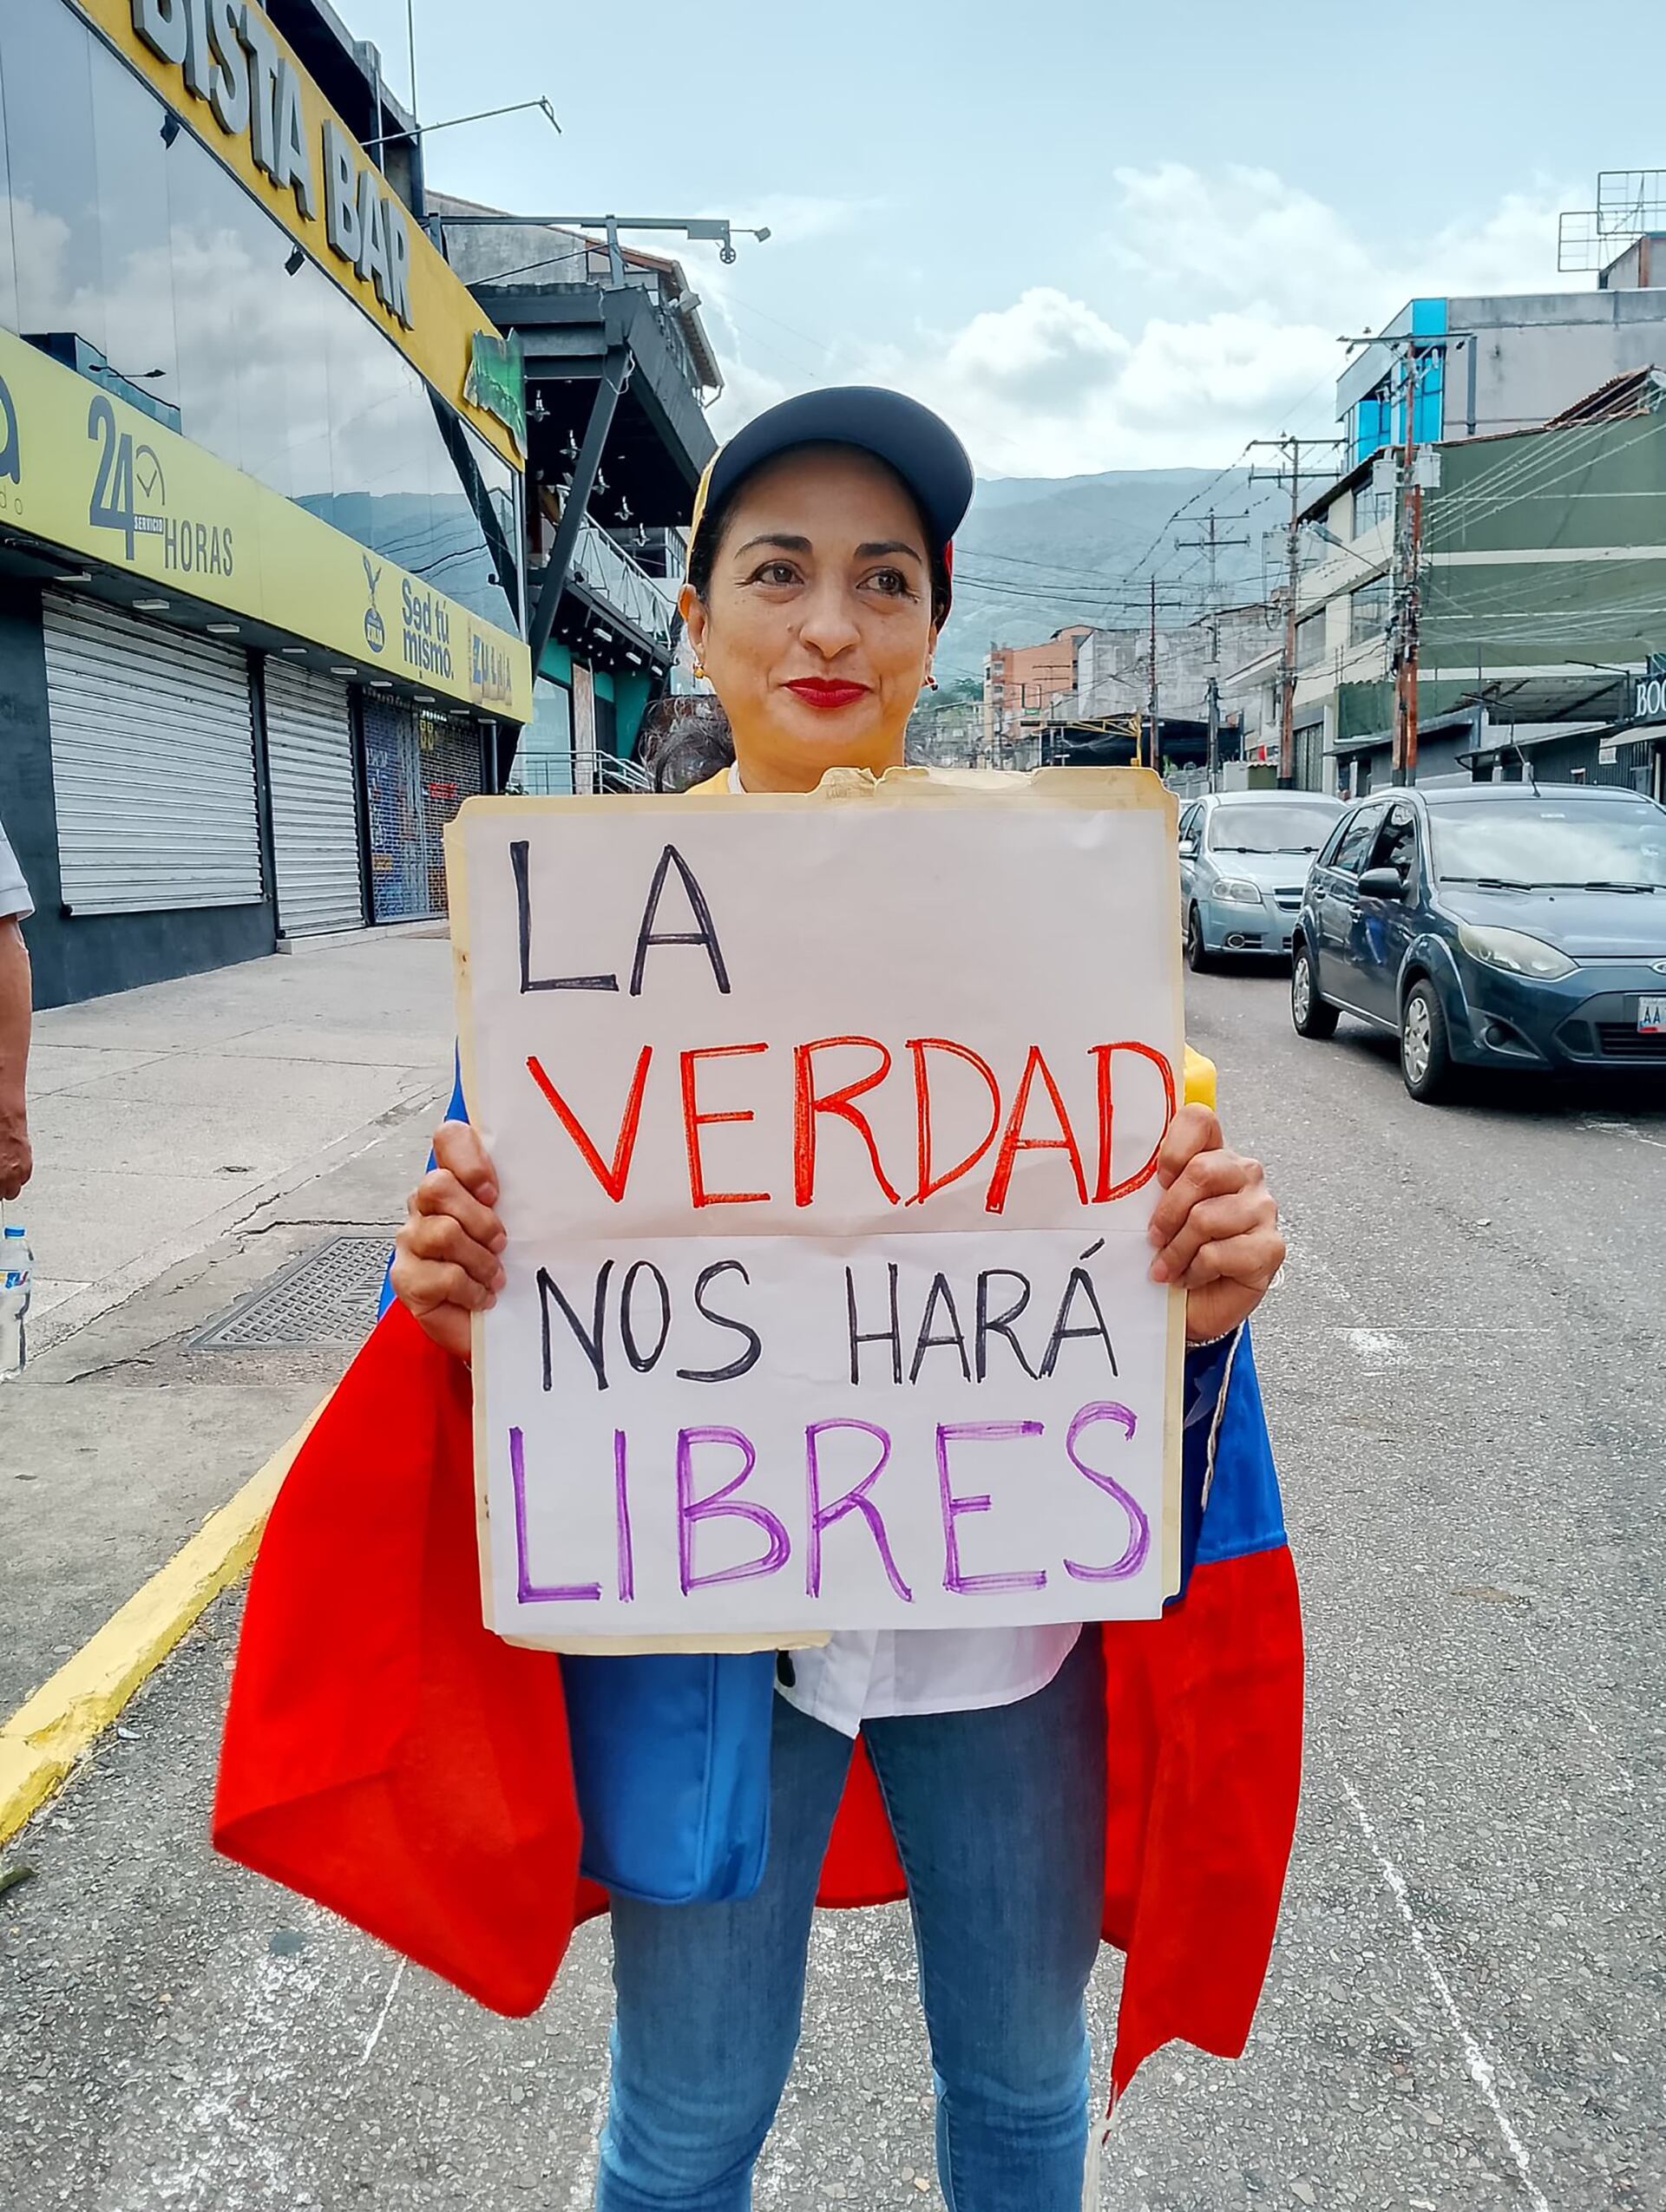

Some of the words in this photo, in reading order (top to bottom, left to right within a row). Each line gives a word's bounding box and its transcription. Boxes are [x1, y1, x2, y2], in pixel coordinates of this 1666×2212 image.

[322, 118, 415, 331] BAR
[89, 396, 134, 560] 24
[134, 515, 163, 533] SERVICIO
[165, 518, 233, 577] HORAS
[510, 841, 731, 997] LA
[527, 1037, 1177, 1214] VERDAD
[536, 1260, 761, 1391] NOS
[846, 1239, 1119, 1385] HARÁ
[509, 1401, 1151, 1604] LIBRES
